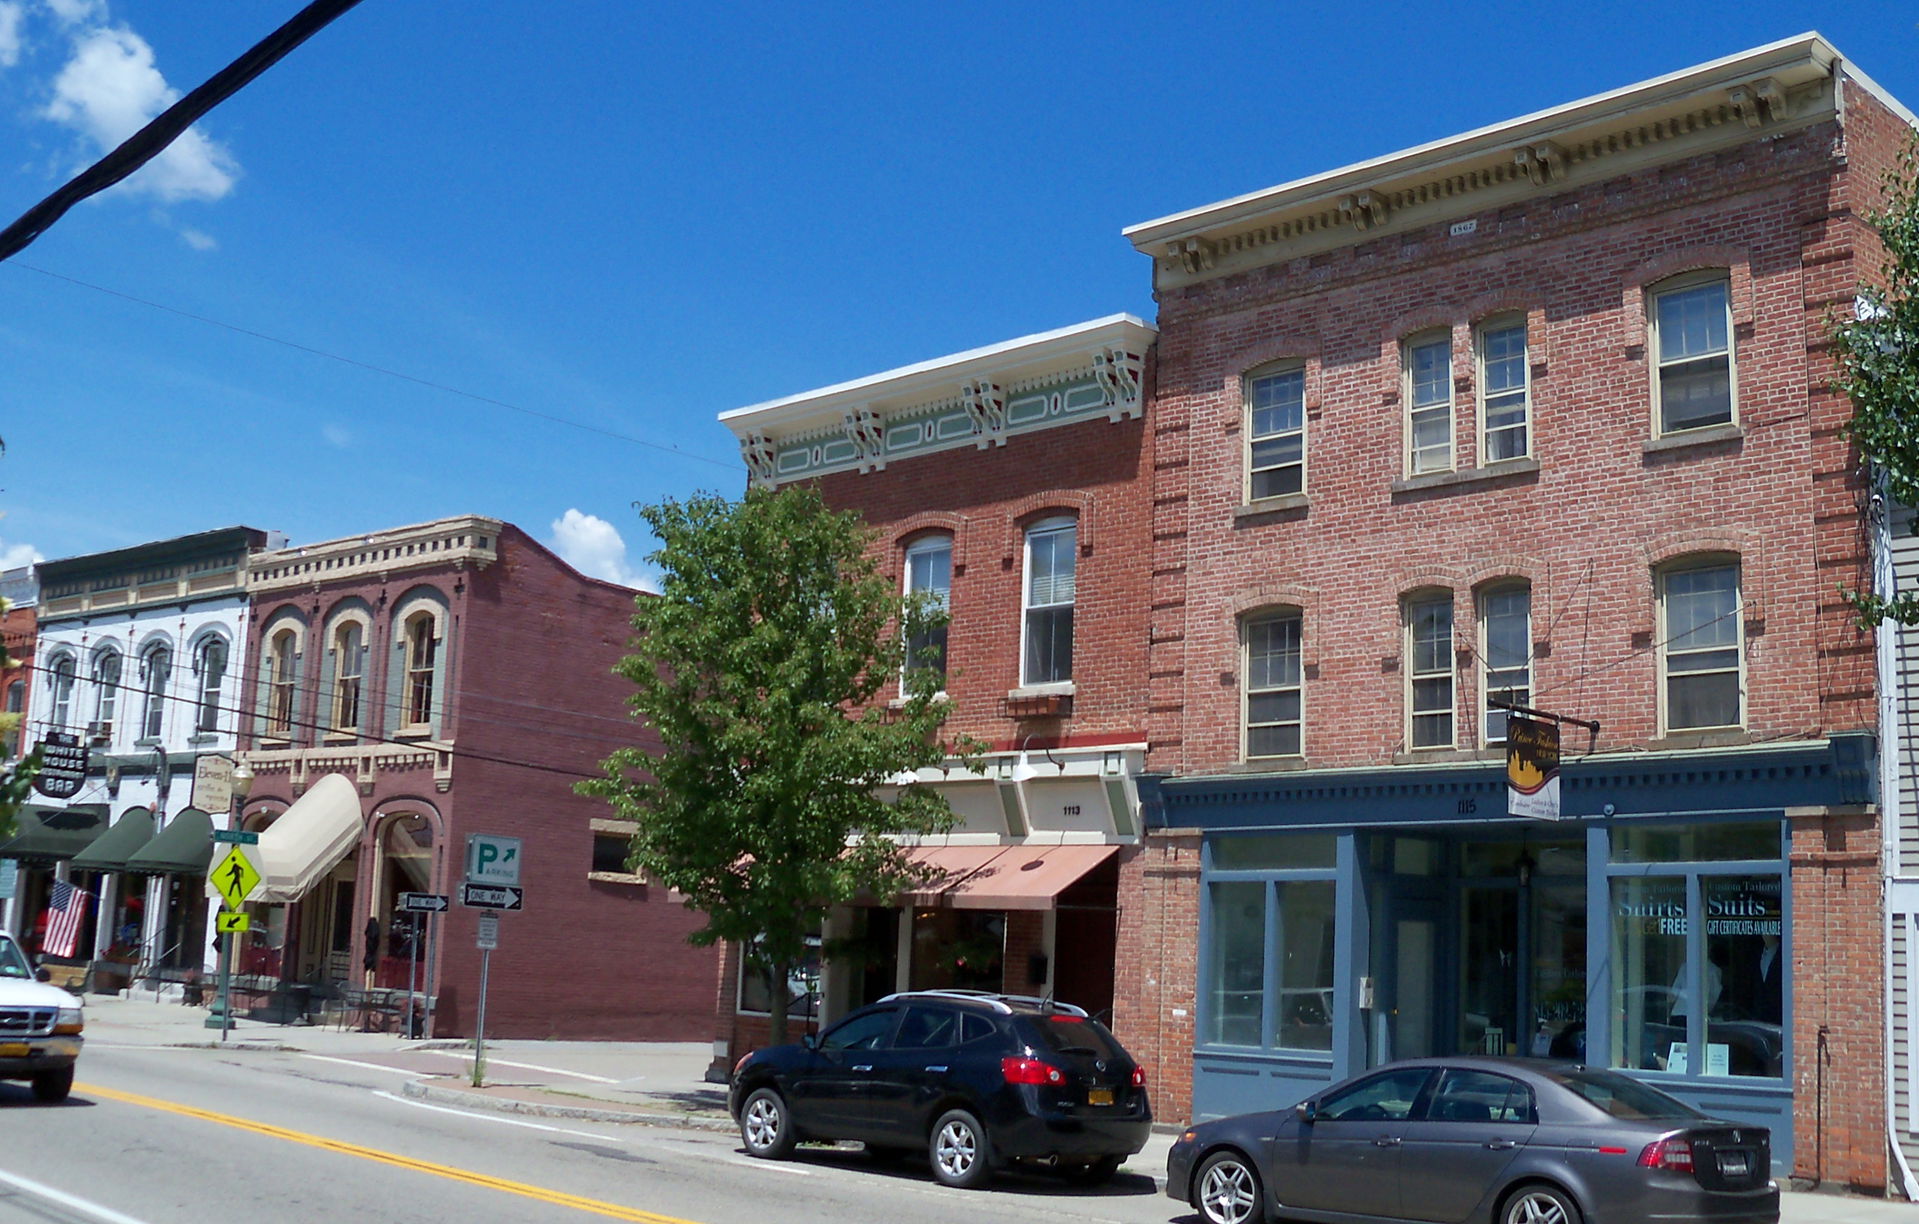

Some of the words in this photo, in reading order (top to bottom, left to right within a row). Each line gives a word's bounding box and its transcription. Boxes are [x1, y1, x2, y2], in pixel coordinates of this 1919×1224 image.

[41, 755, 84, 769] HOUSE
[45, 778, 75, 792] BAR
[1063, 805, 1080, 816] 1113
[1458, 799, 1476, 814] 1115
[470, 890, 485, 901] ONE
[491, 892, 506, 902] WAY
[1708, 893, 1767, 916] Suits
[1660, 917, 1688, 936] FREE
[1707, 919, 1719, 936] GIFT
[1720, 919, 1754, 936] CERTIFICATES
[1754, 920, 1781, 936] AVAILABLE
